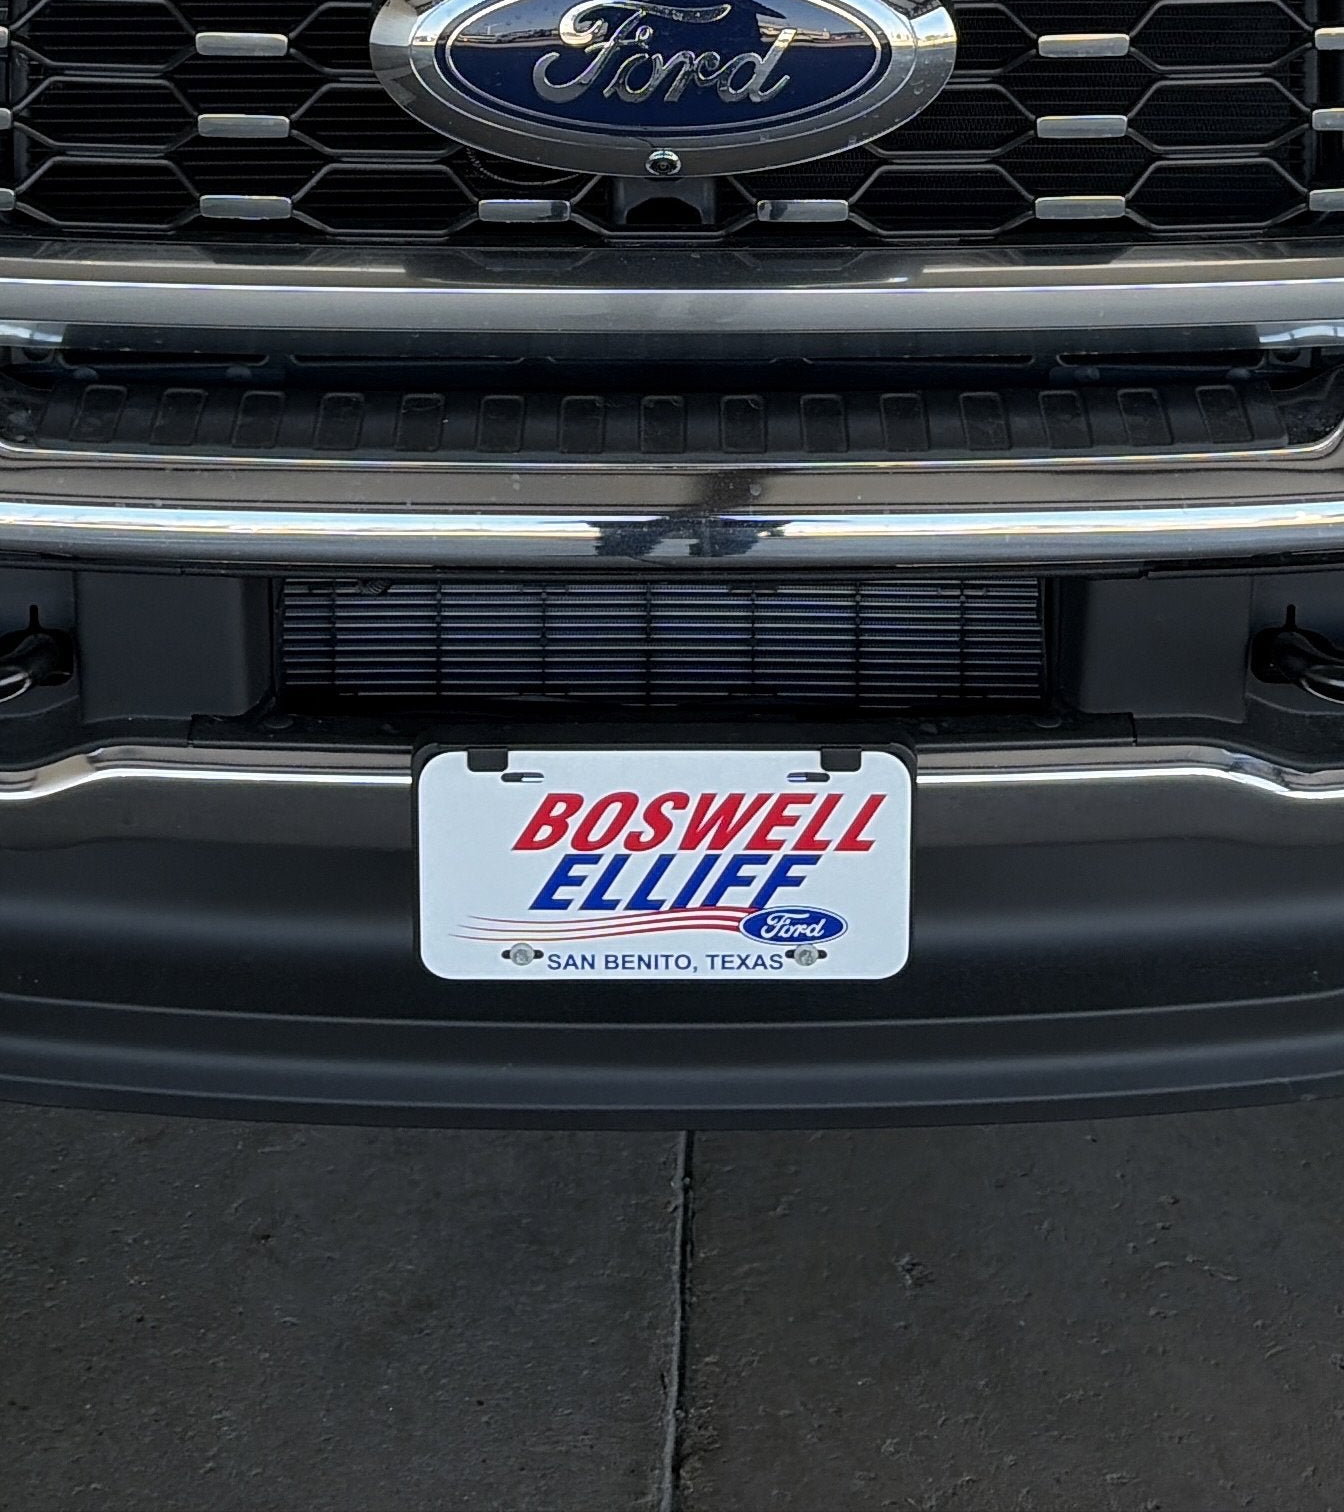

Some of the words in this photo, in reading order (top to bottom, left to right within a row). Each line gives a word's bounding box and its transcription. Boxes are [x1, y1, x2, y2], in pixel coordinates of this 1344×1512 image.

[511, 791, 888, 852] BOSWELL
[529, 854, 822, 911] ELLIFF
[759, 911, 825, 939] Ford
[547, 954, 595, 970] SAN
[605, 954, 698, 973] BENITO,
[706, 954, 783, 970] TEXAS
